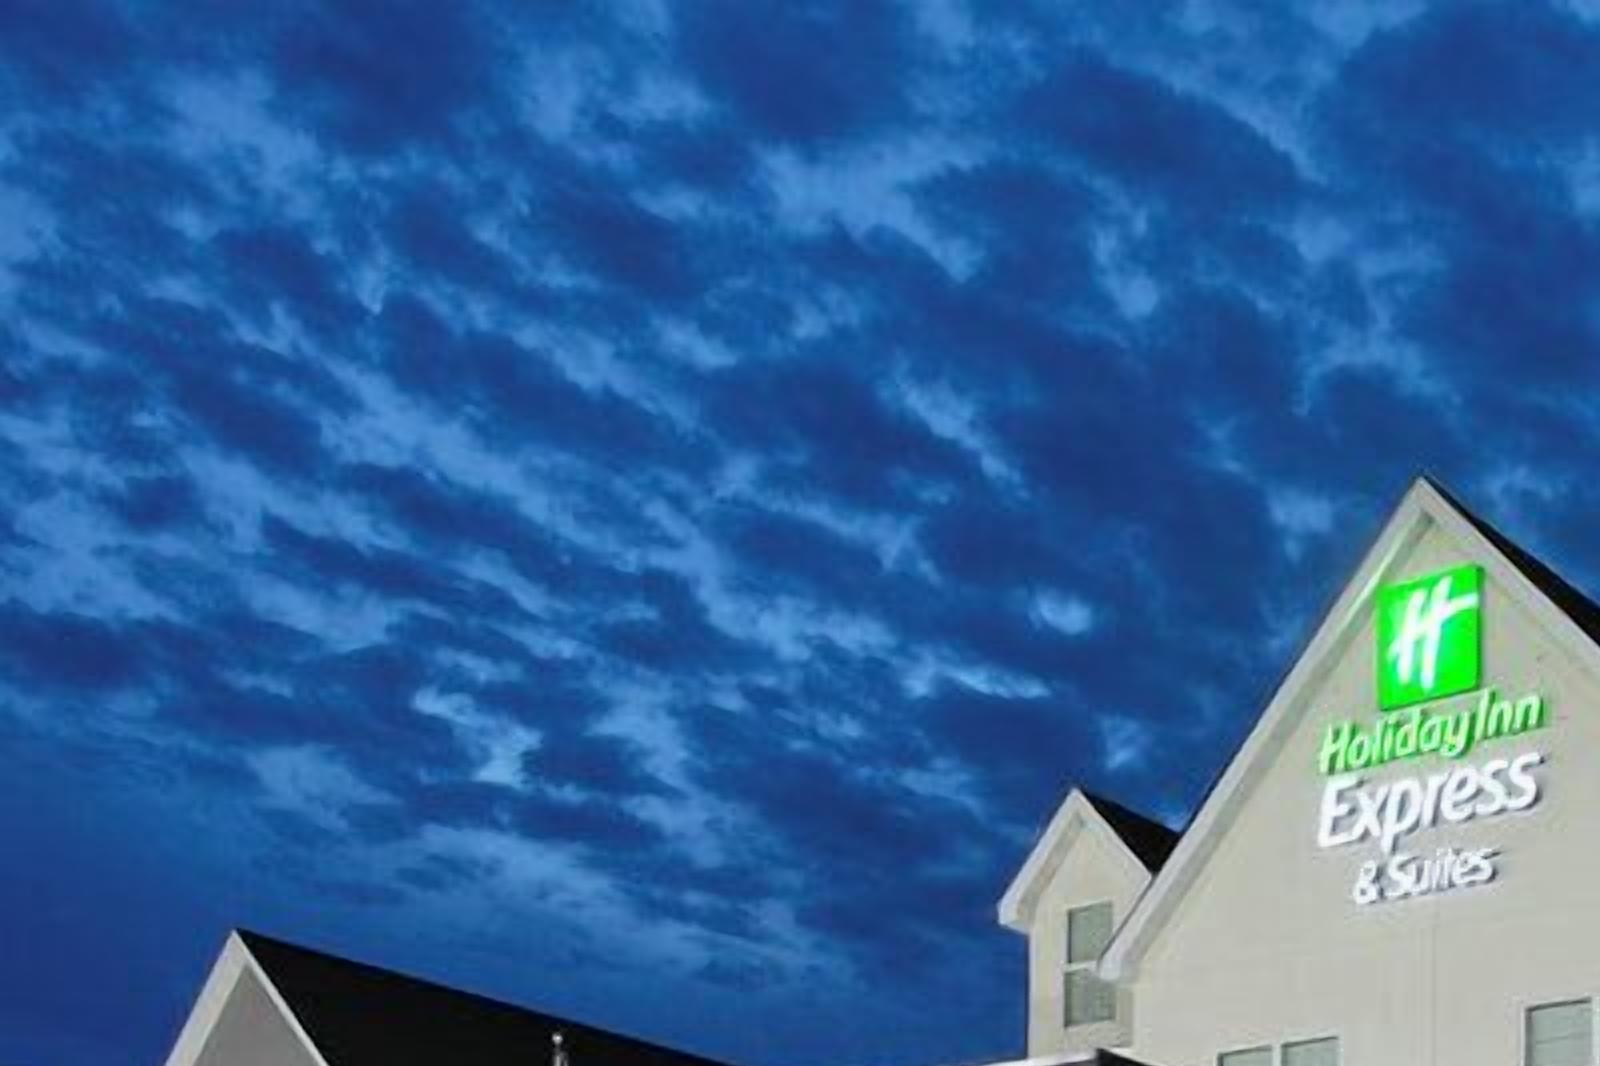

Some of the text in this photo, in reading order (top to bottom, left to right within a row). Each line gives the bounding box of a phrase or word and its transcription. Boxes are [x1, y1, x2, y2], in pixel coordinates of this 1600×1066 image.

[1320, 686, 1543, 776] Holiday Inn
[1317, 752, 1543, 852] Express
[1354, 847, 1500, 904] & Suites
